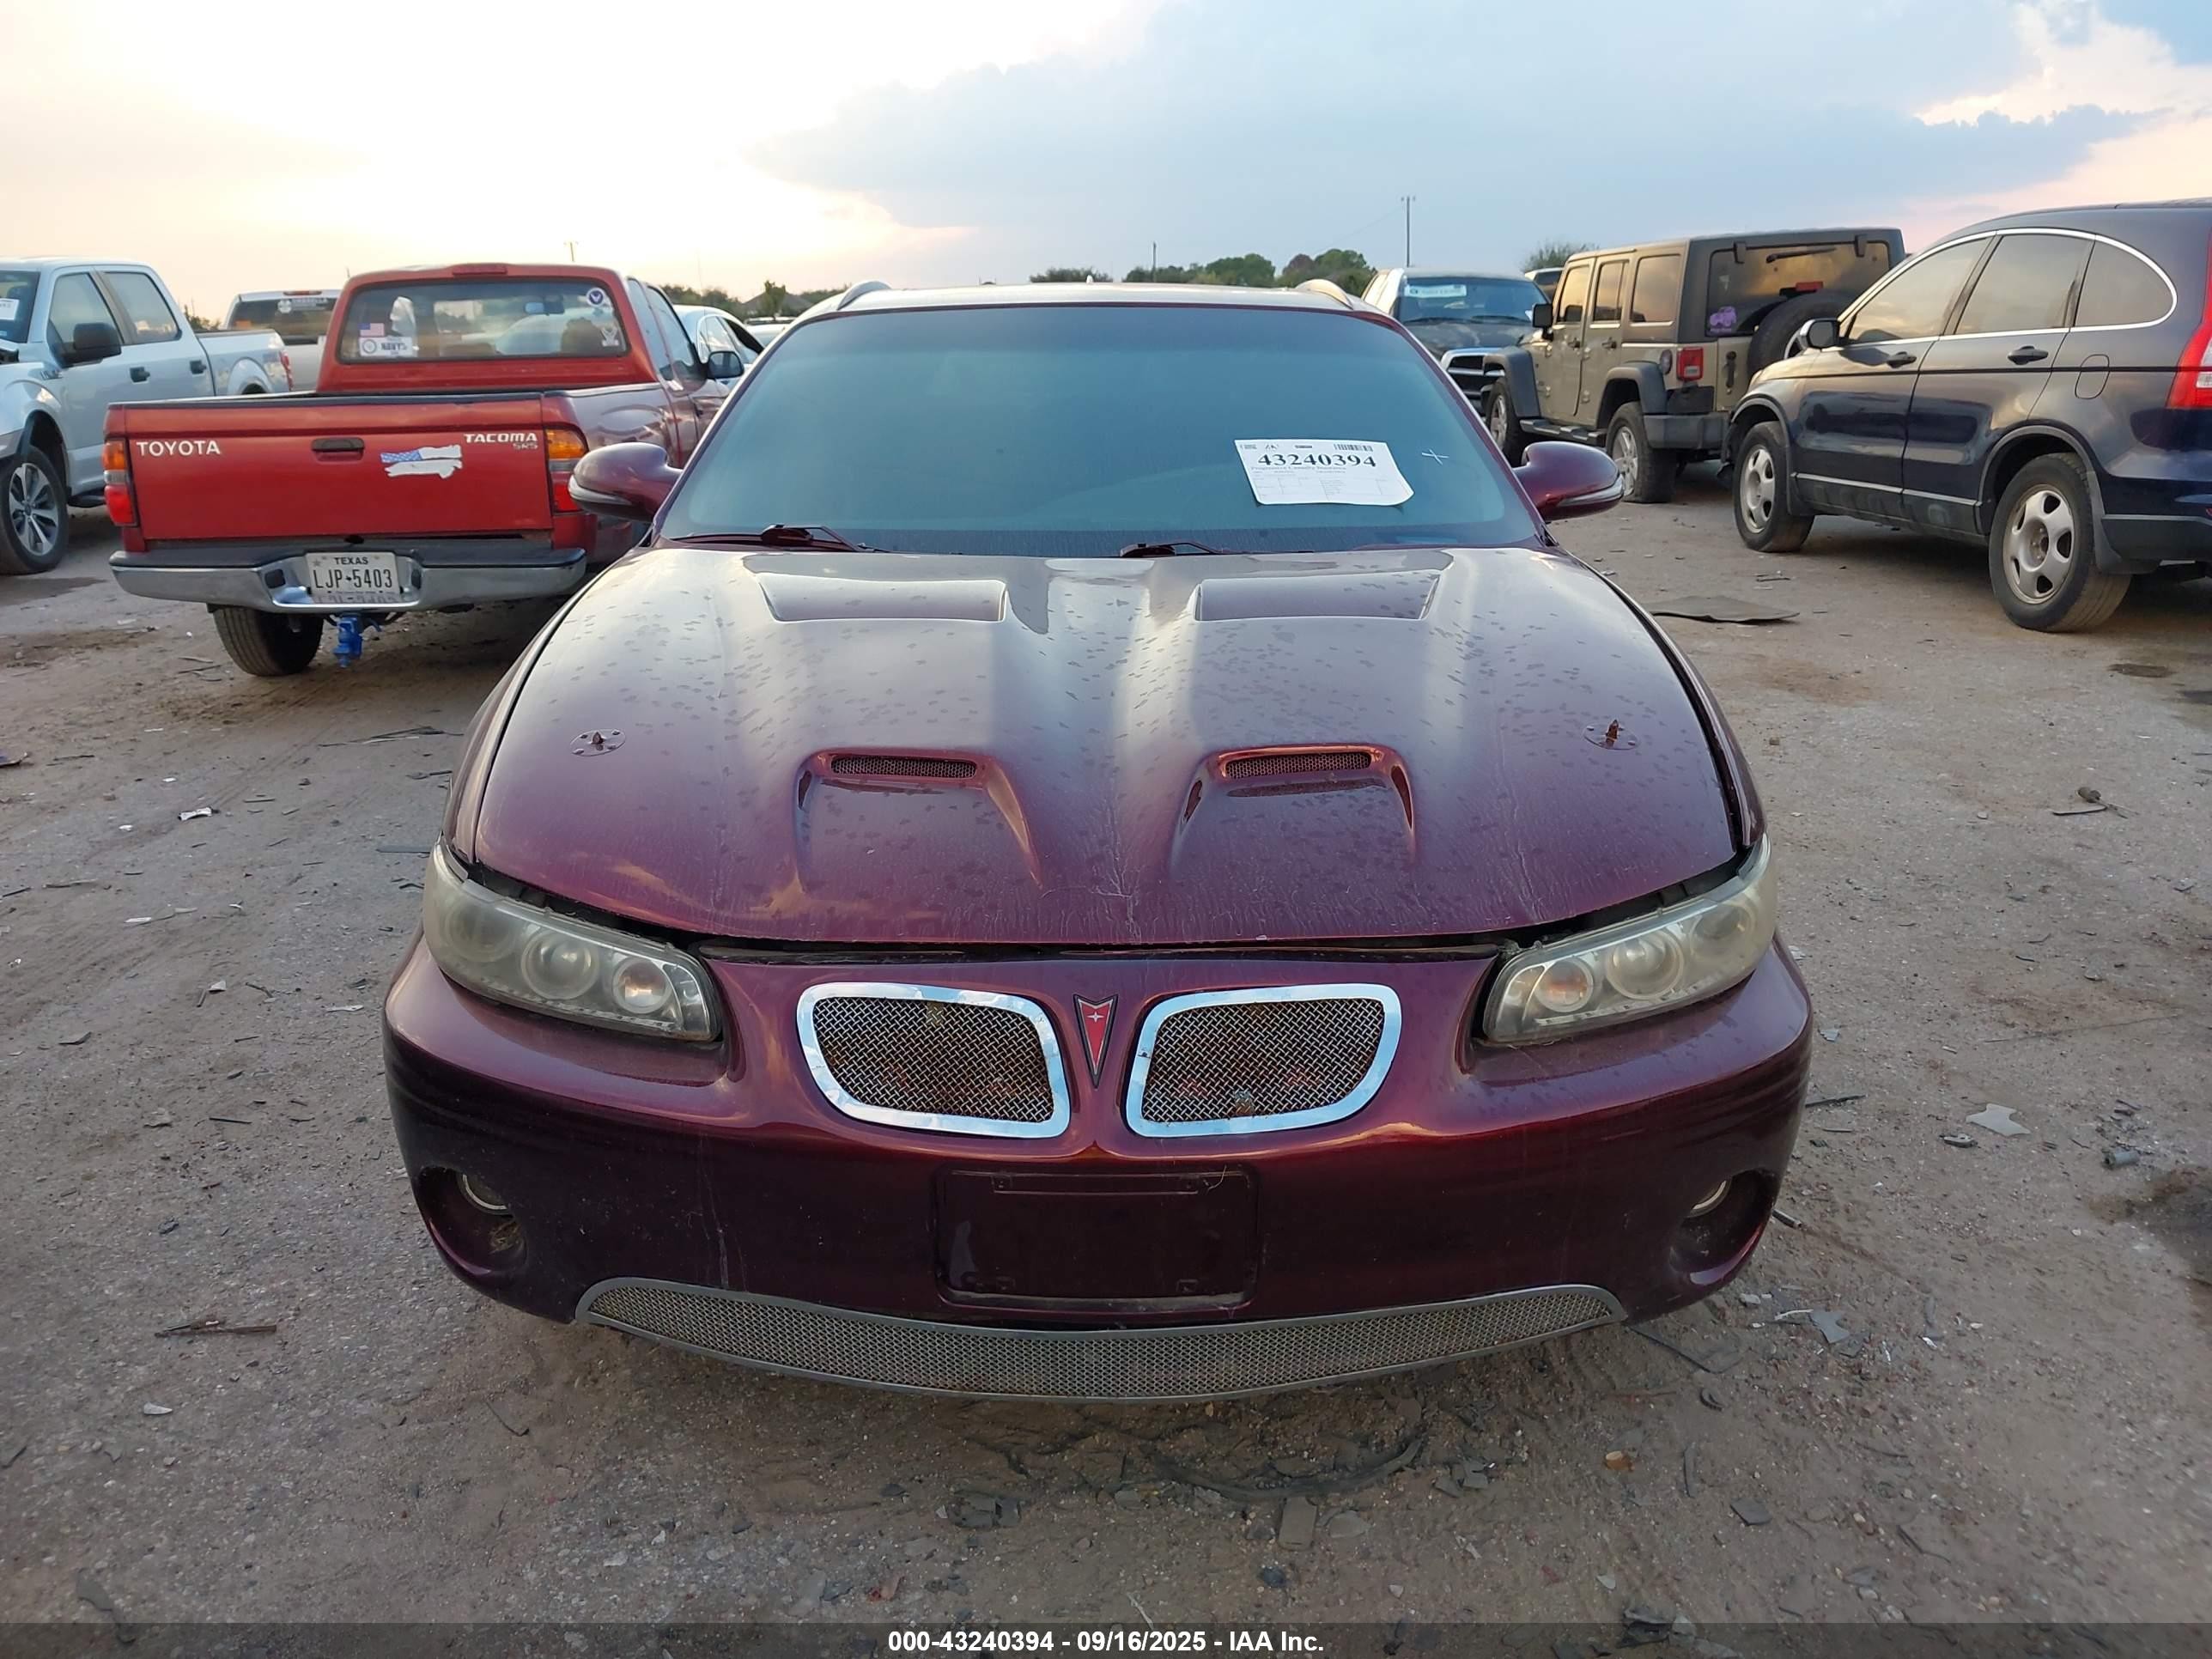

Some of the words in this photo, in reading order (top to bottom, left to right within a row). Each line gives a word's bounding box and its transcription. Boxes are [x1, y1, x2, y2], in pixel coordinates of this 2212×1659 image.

[464, 433, 538, 443] TACOMA
[136, 441, 221, 457] TOYOTA
[1258, 453, 1376, 467] 43240394
[313, 569, 343, 588] LJP
[352, 569, 392, 588] 5403
